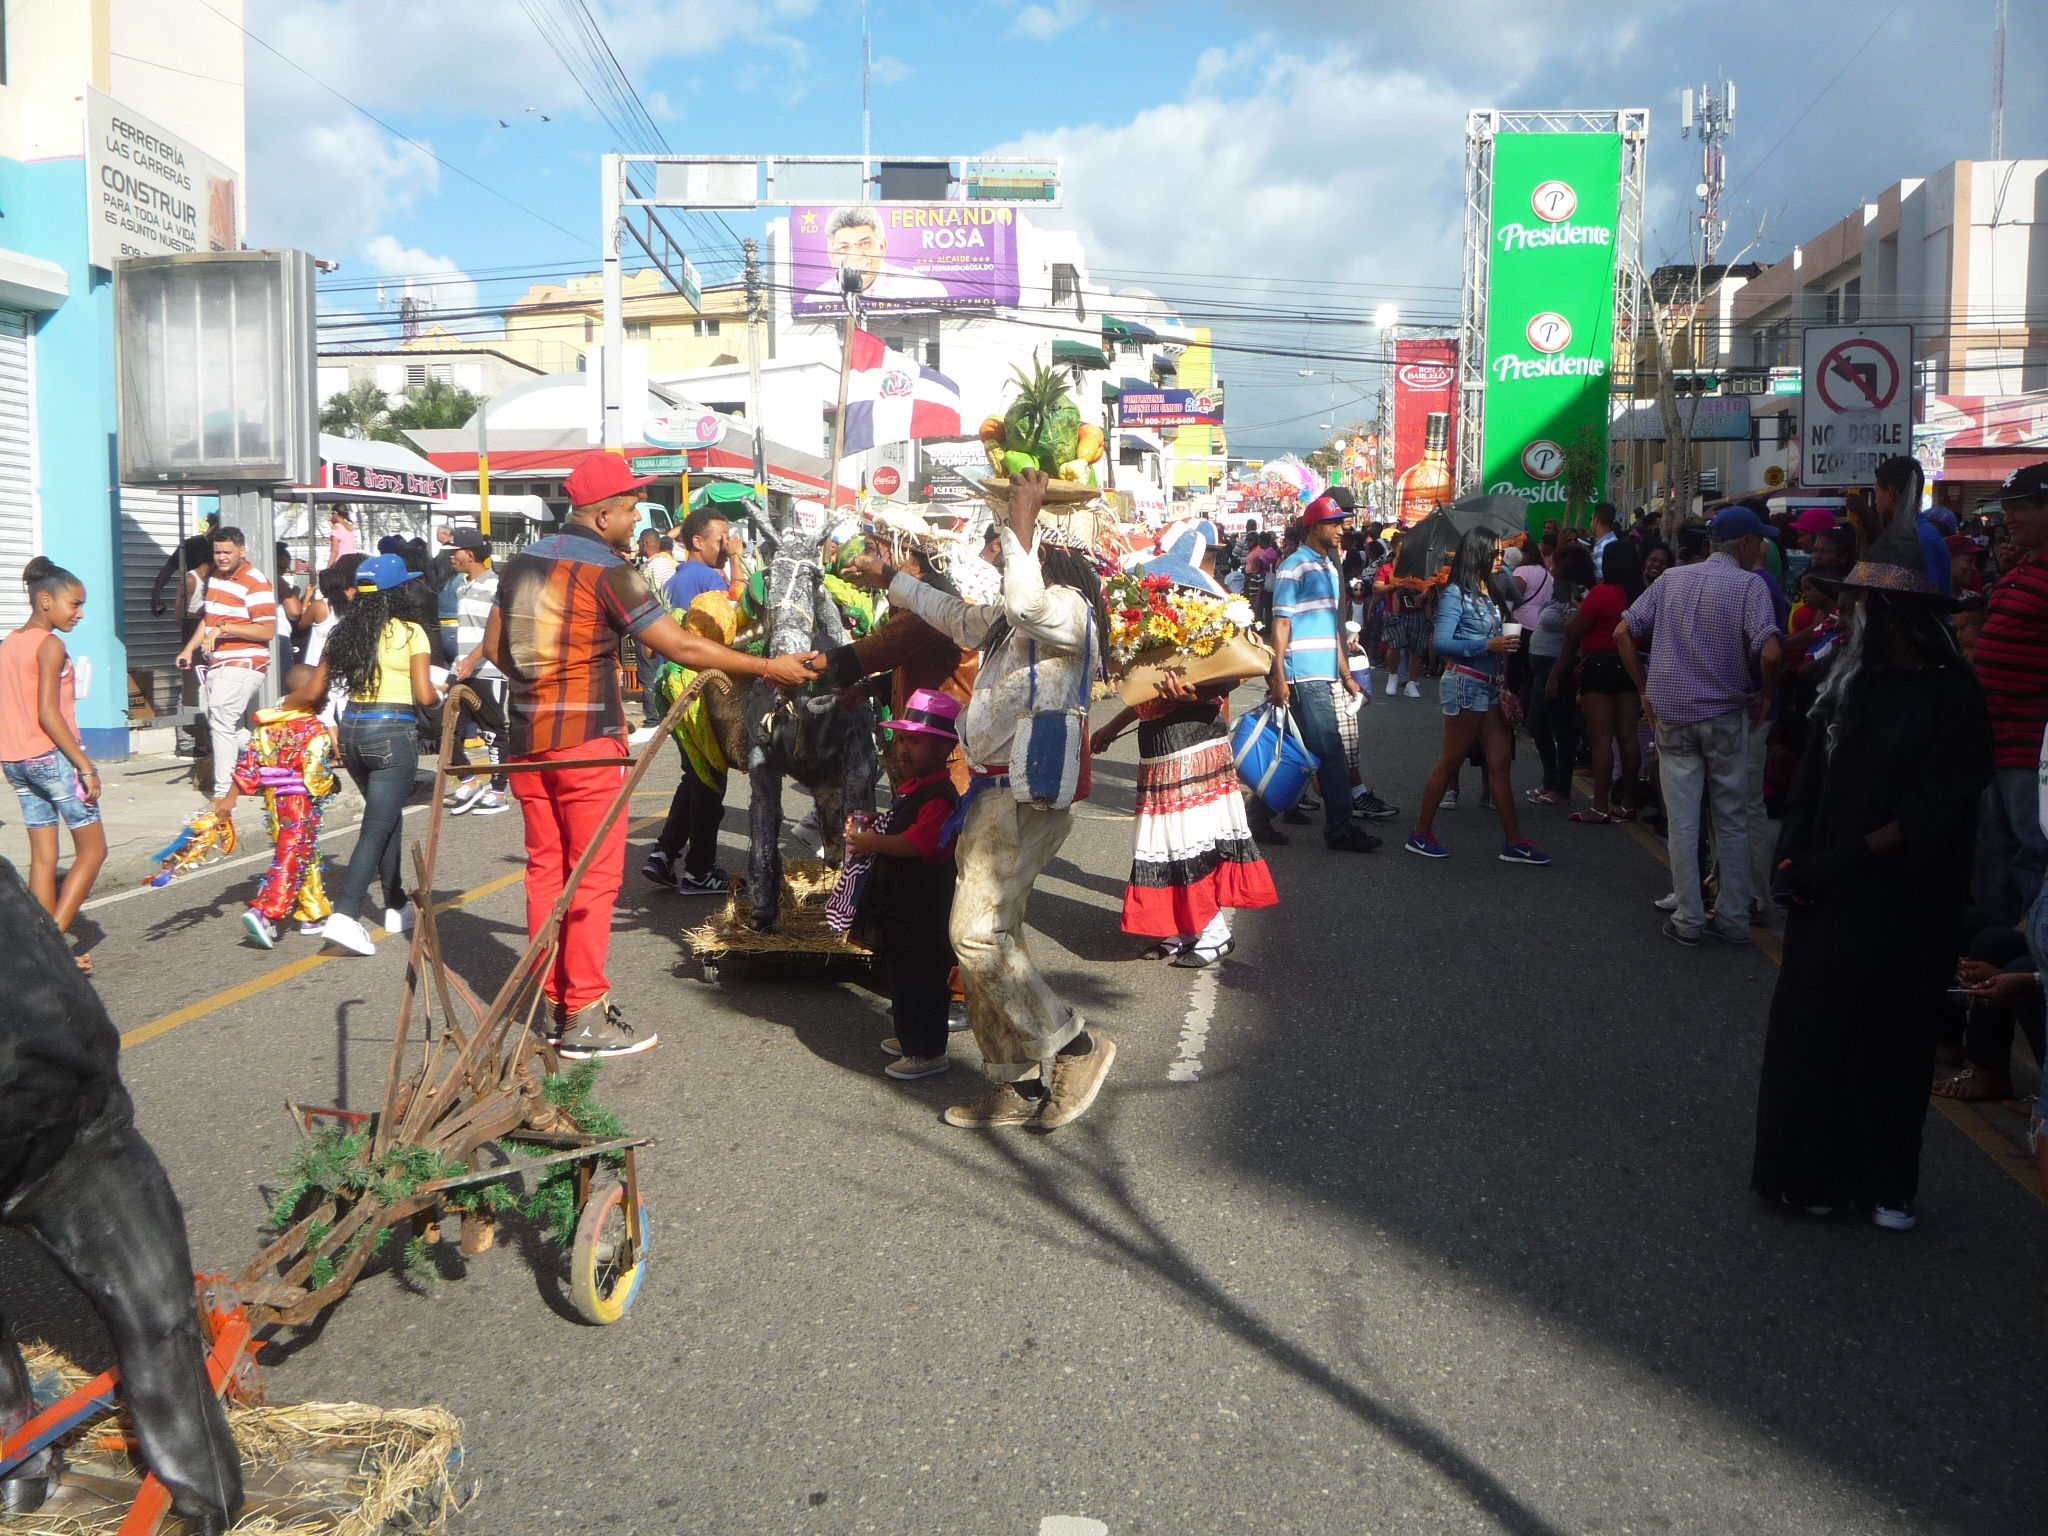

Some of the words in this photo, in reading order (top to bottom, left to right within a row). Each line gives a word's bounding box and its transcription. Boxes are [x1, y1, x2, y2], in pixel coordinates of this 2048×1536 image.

[112, 117, 186, 169] FERRETERÍA
[106, 135, 130, 160] LAS
[133, 150, 191, 191] CARRERAS
[101, 164, 197, 228] CONSTRUIR
[103, 192, 131, 215] PARA
[134, 205, 160, 227] TODA
[163, 218, 174, 234] LA
[175, 224, 197, 244] VIDA
[105, 210, 118, 225] ES
[120, 217, 157, 241] ASUNTO
[159, 232, 197, 254] NUESTRO
[800, 225, 819, 233] PLD
[890, 206, 1013, 229] FERNANDO
[922, 228, 985, 250] ROSA
[1497, 221, 1611, 252] Presidente
[937, 255, 970, 264] ALCALDE
[1492, 353, 1605, 382] Presidente
[1151, 403, 1159, 412] DE
[1811, 424, 1835, 446] NO
[1848, 423, 1902, 445] DOBLE
[336, 464, 360, 487] The
[364, 467, 404, 494] Sherry
[407, 472, 437, 497] Drink
[1488, 481, 1600, 504] Presidee
